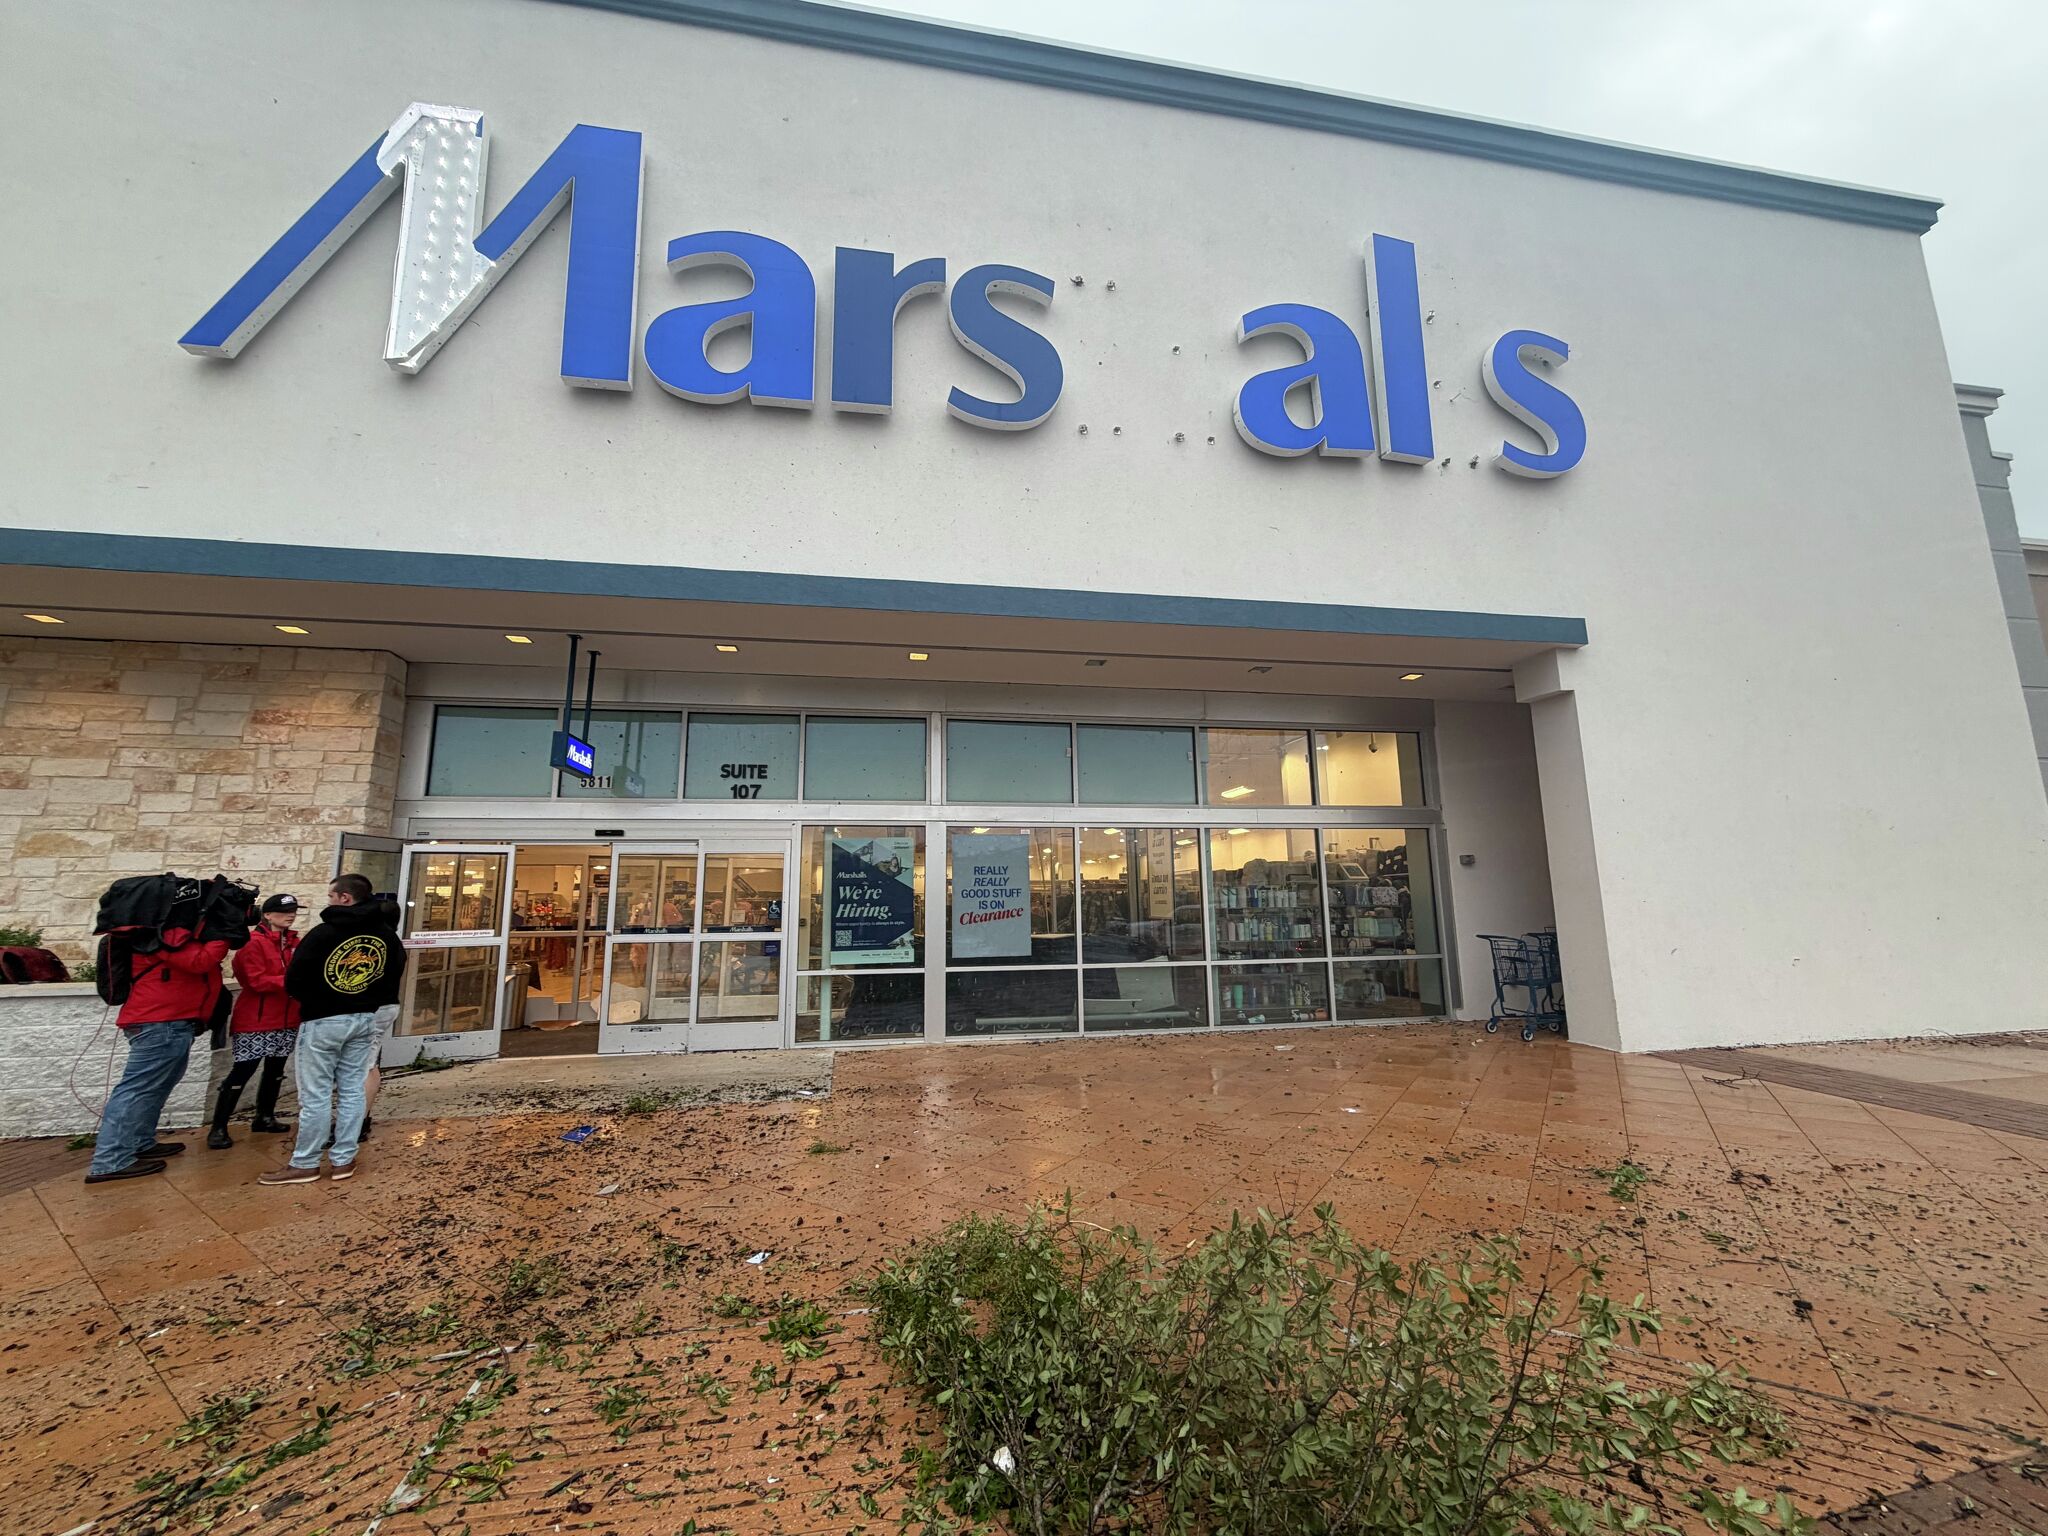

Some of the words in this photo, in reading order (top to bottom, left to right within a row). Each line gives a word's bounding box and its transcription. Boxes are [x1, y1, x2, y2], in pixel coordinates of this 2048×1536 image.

[720, 764, 768, 779] SUITE
[580, 775, 611, 788] 5811
[730, 784, 762, 799] 107
[836, 871, 867, 879] Marshalls
[974, 866, 1008, 875] REALLY
[974, 877, 1010, 887] REALLY
[838, 885, 882, 900] We're
[961, 889, 990, 898] GOOD
[992, 888, 1022, 898] STUFF
[835, 902, 892, 920] Hiring.
[979, 900, 988, 910] IS
[990, 900, 1005, 910] ON
[959, 907, 1024, 925] Clearance
